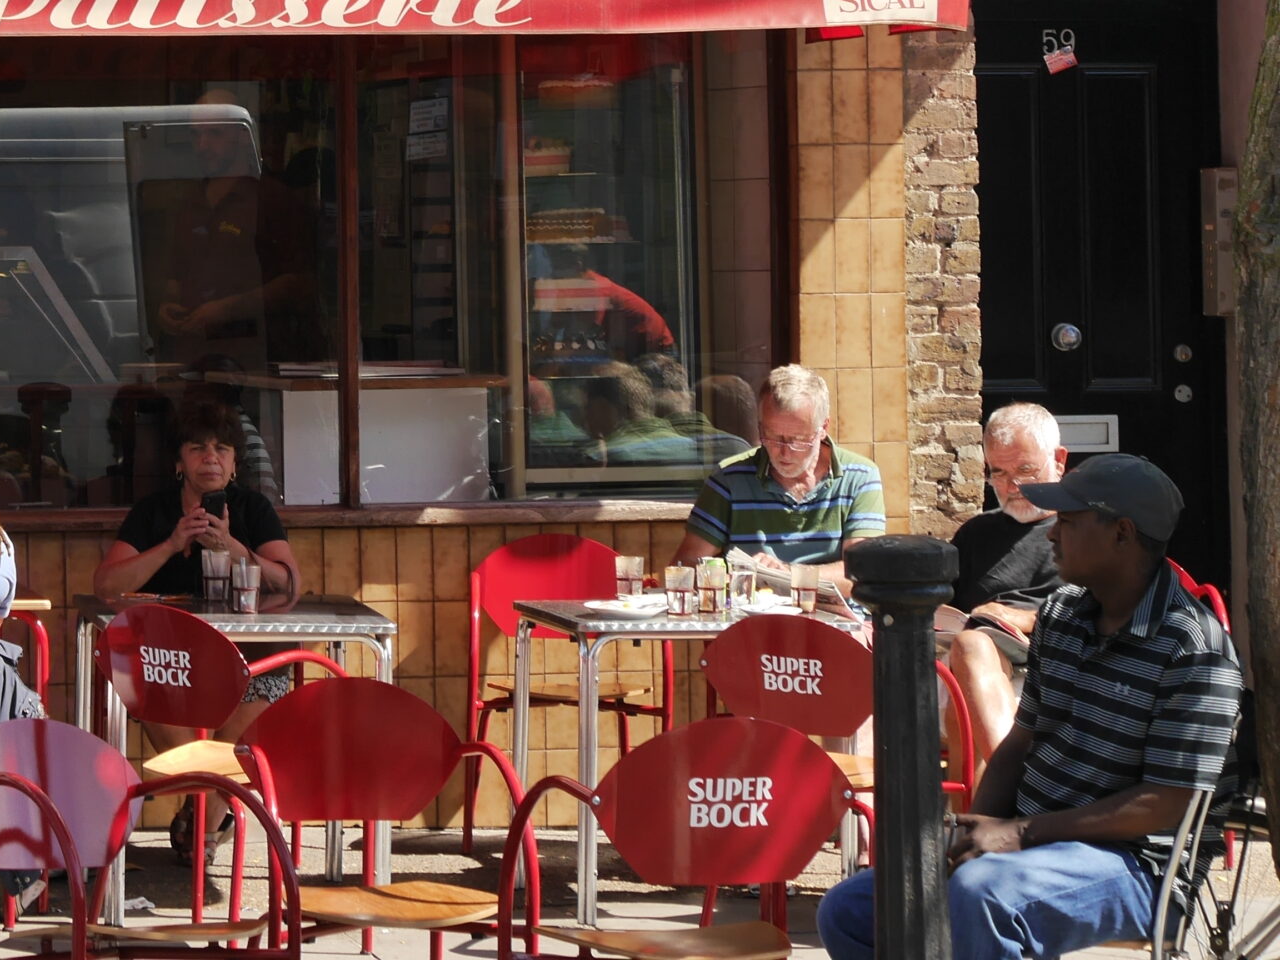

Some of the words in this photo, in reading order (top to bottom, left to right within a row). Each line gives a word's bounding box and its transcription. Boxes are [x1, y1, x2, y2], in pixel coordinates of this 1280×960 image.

[1042, 28, 1076, 55] 59
[139, 645, 191, 669] SUPER
[761, 654, 823, 677] SUPER
[143, 665, 191, 688] BOCK
[763, 673, 822, 695] BOCK
[687, 776, 773, 802] SUPER
[689, 802, 769, 828] BOCK
